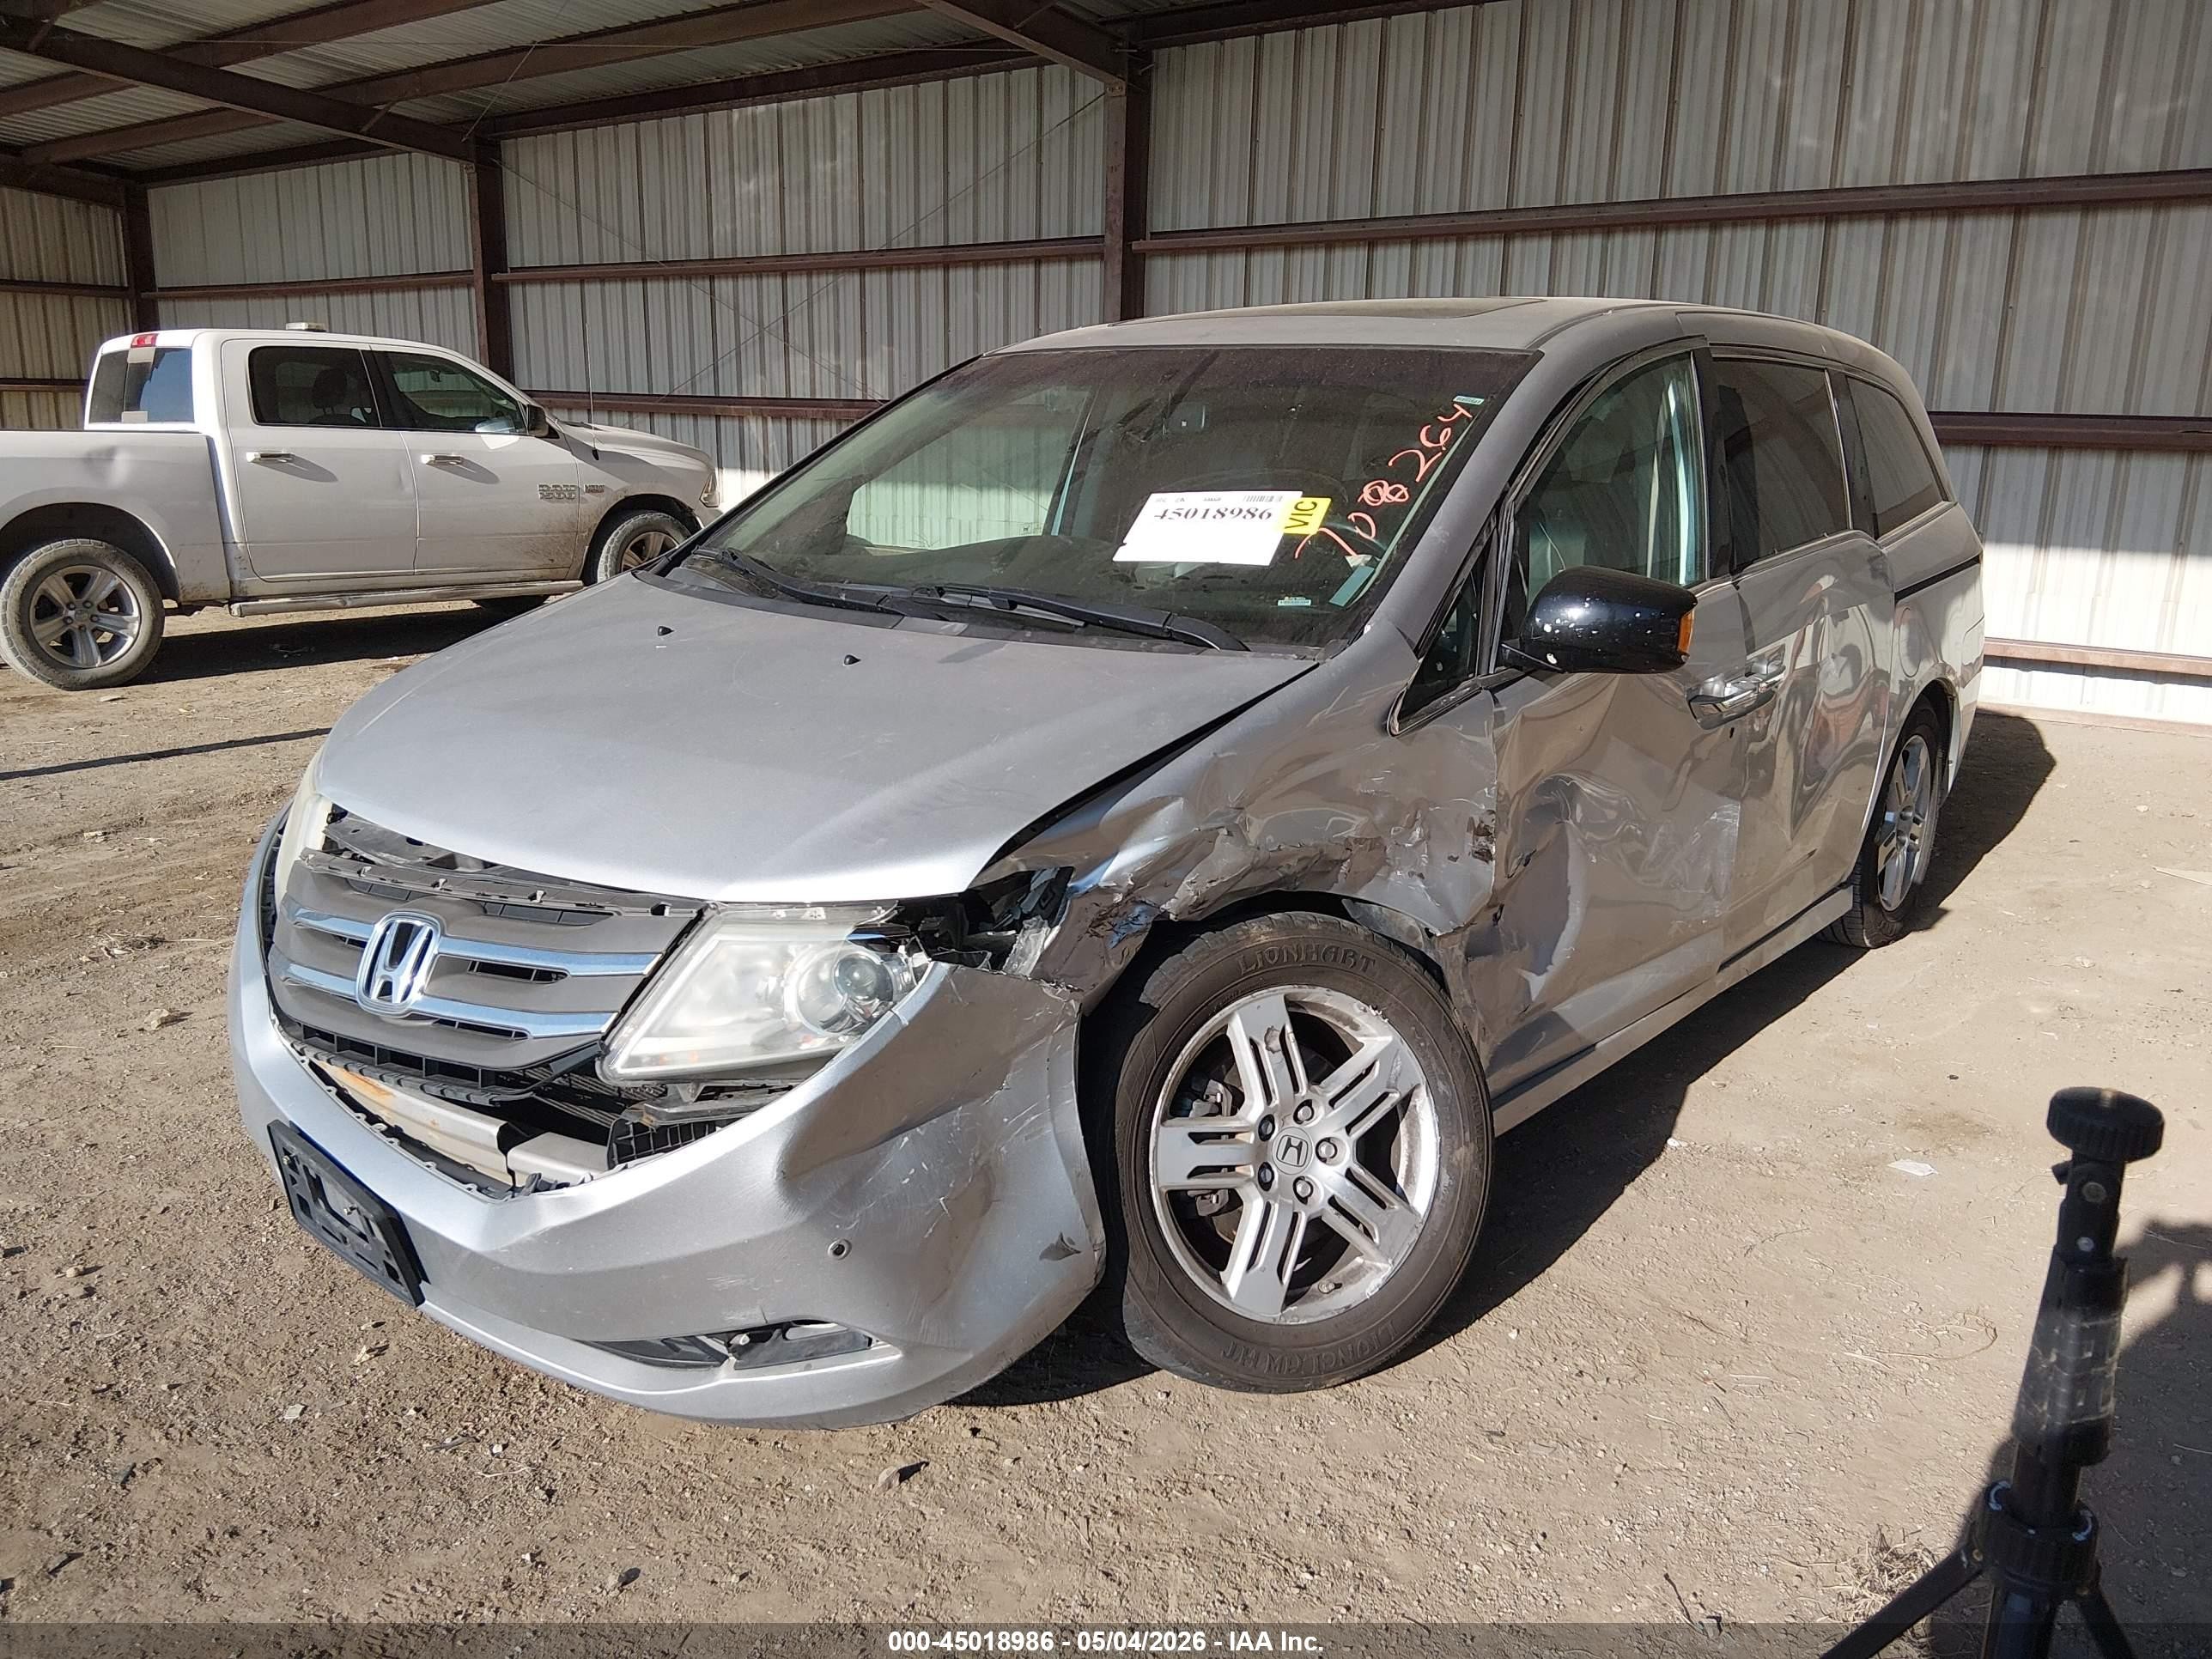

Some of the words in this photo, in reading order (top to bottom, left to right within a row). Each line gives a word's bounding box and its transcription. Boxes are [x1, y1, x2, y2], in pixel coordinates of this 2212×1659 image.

[1153, 507, 1273, 520] 45018986
[1284, 500, 1318, 530] VIC
[1237, 944, 1376, 976] LIONHART
